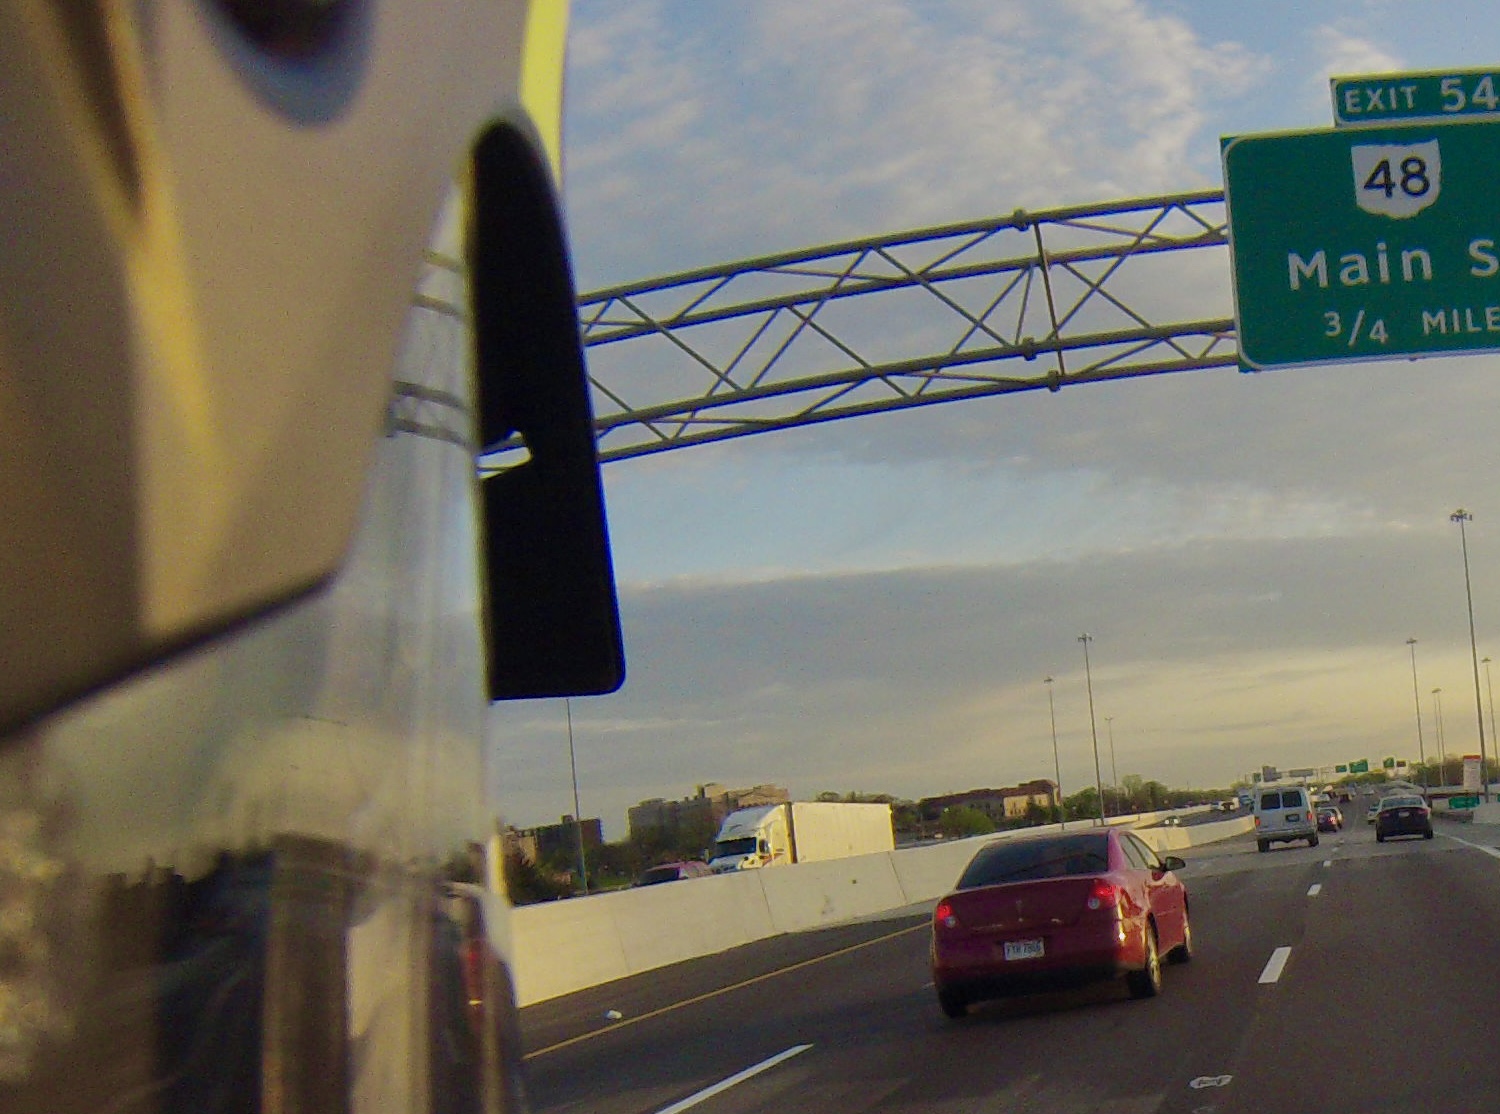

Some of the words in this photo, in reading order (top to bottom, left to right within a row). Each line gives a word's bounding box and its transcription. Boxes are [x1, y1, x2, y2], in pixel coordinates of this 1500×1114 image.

[1344, 85, 1418, 114] EXIT
[1440, 75, 1500, 112] 54
[1363, 157, 1431, 198] 48
[1287, 242, 1433, 291] Main
[1324, 309, 1389, 346] 3/4
